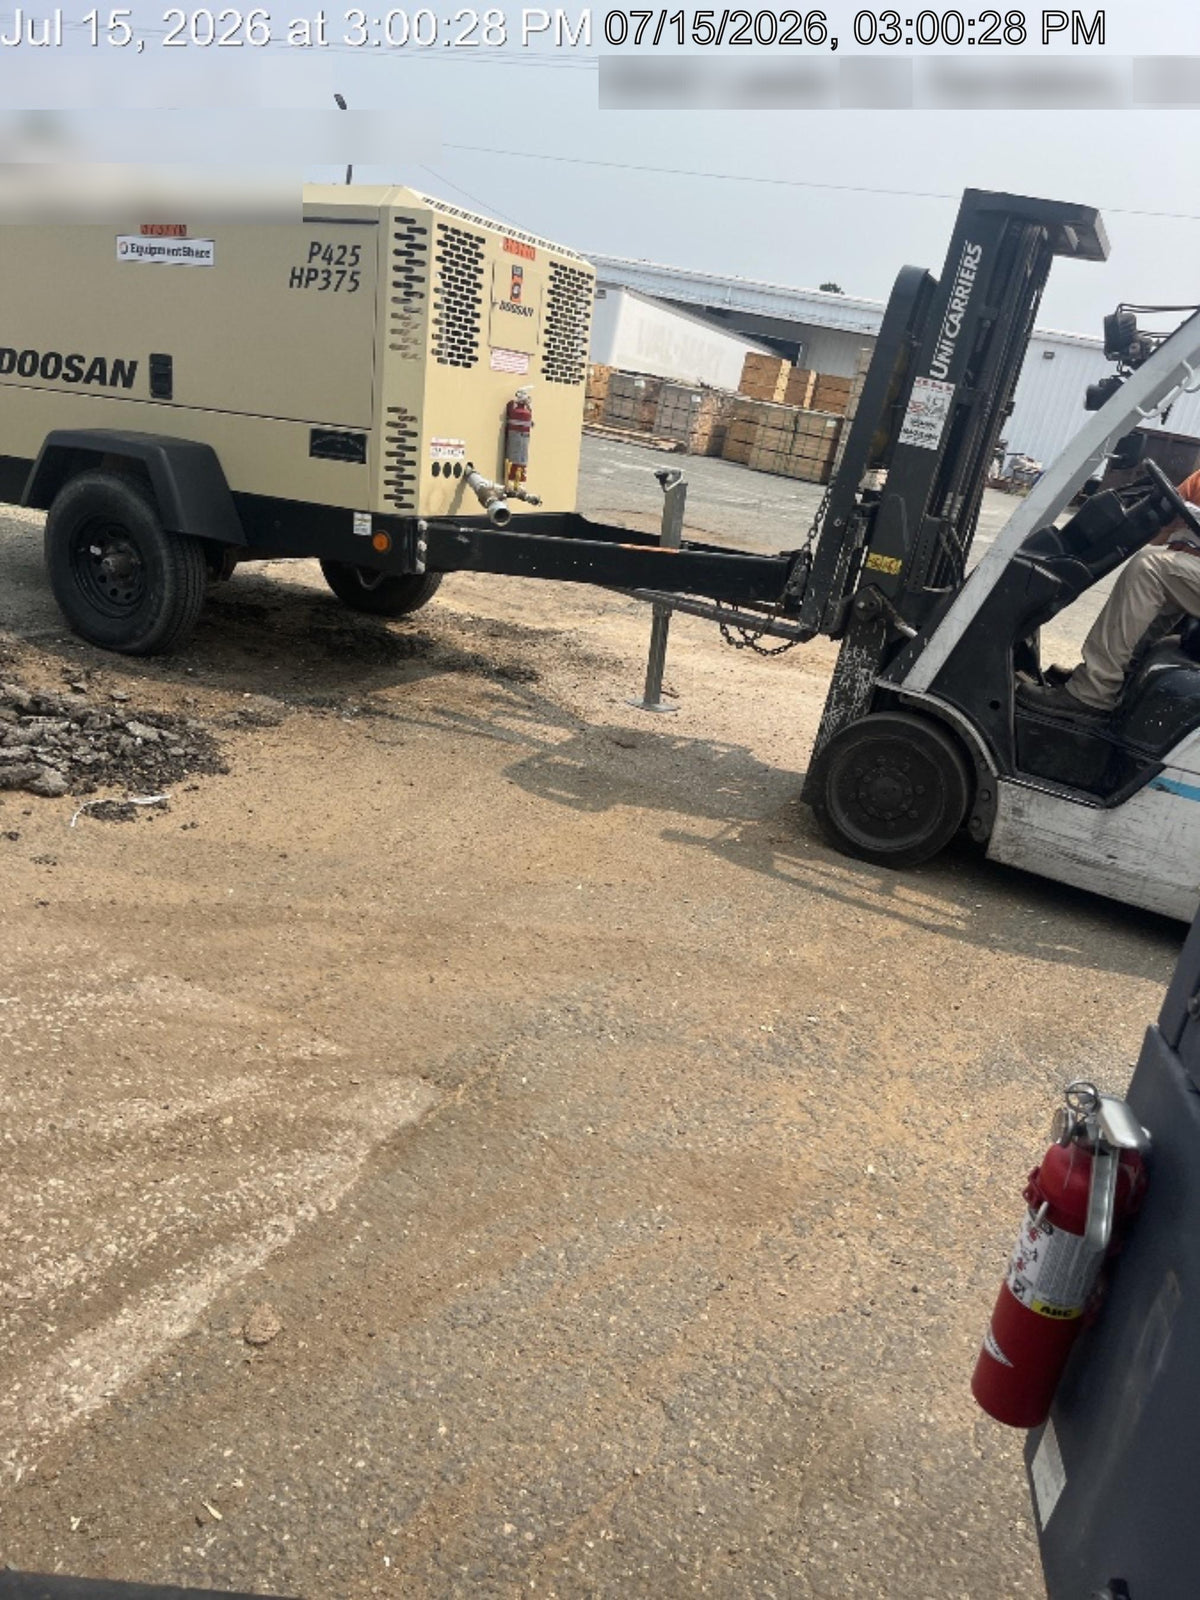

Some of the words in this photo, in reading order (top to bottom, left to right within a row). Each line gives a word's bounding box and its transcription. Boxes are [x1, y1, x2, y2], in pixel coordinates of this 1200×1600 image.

[130, 243, 211, 258] EquipmentShare
[307, 241, 361, 267] P425
[289, 266, 361, 293] HP375
[929, 241, 982, 380] UNICARRIERS
[0, 347, 138, 389] DOOSAN
